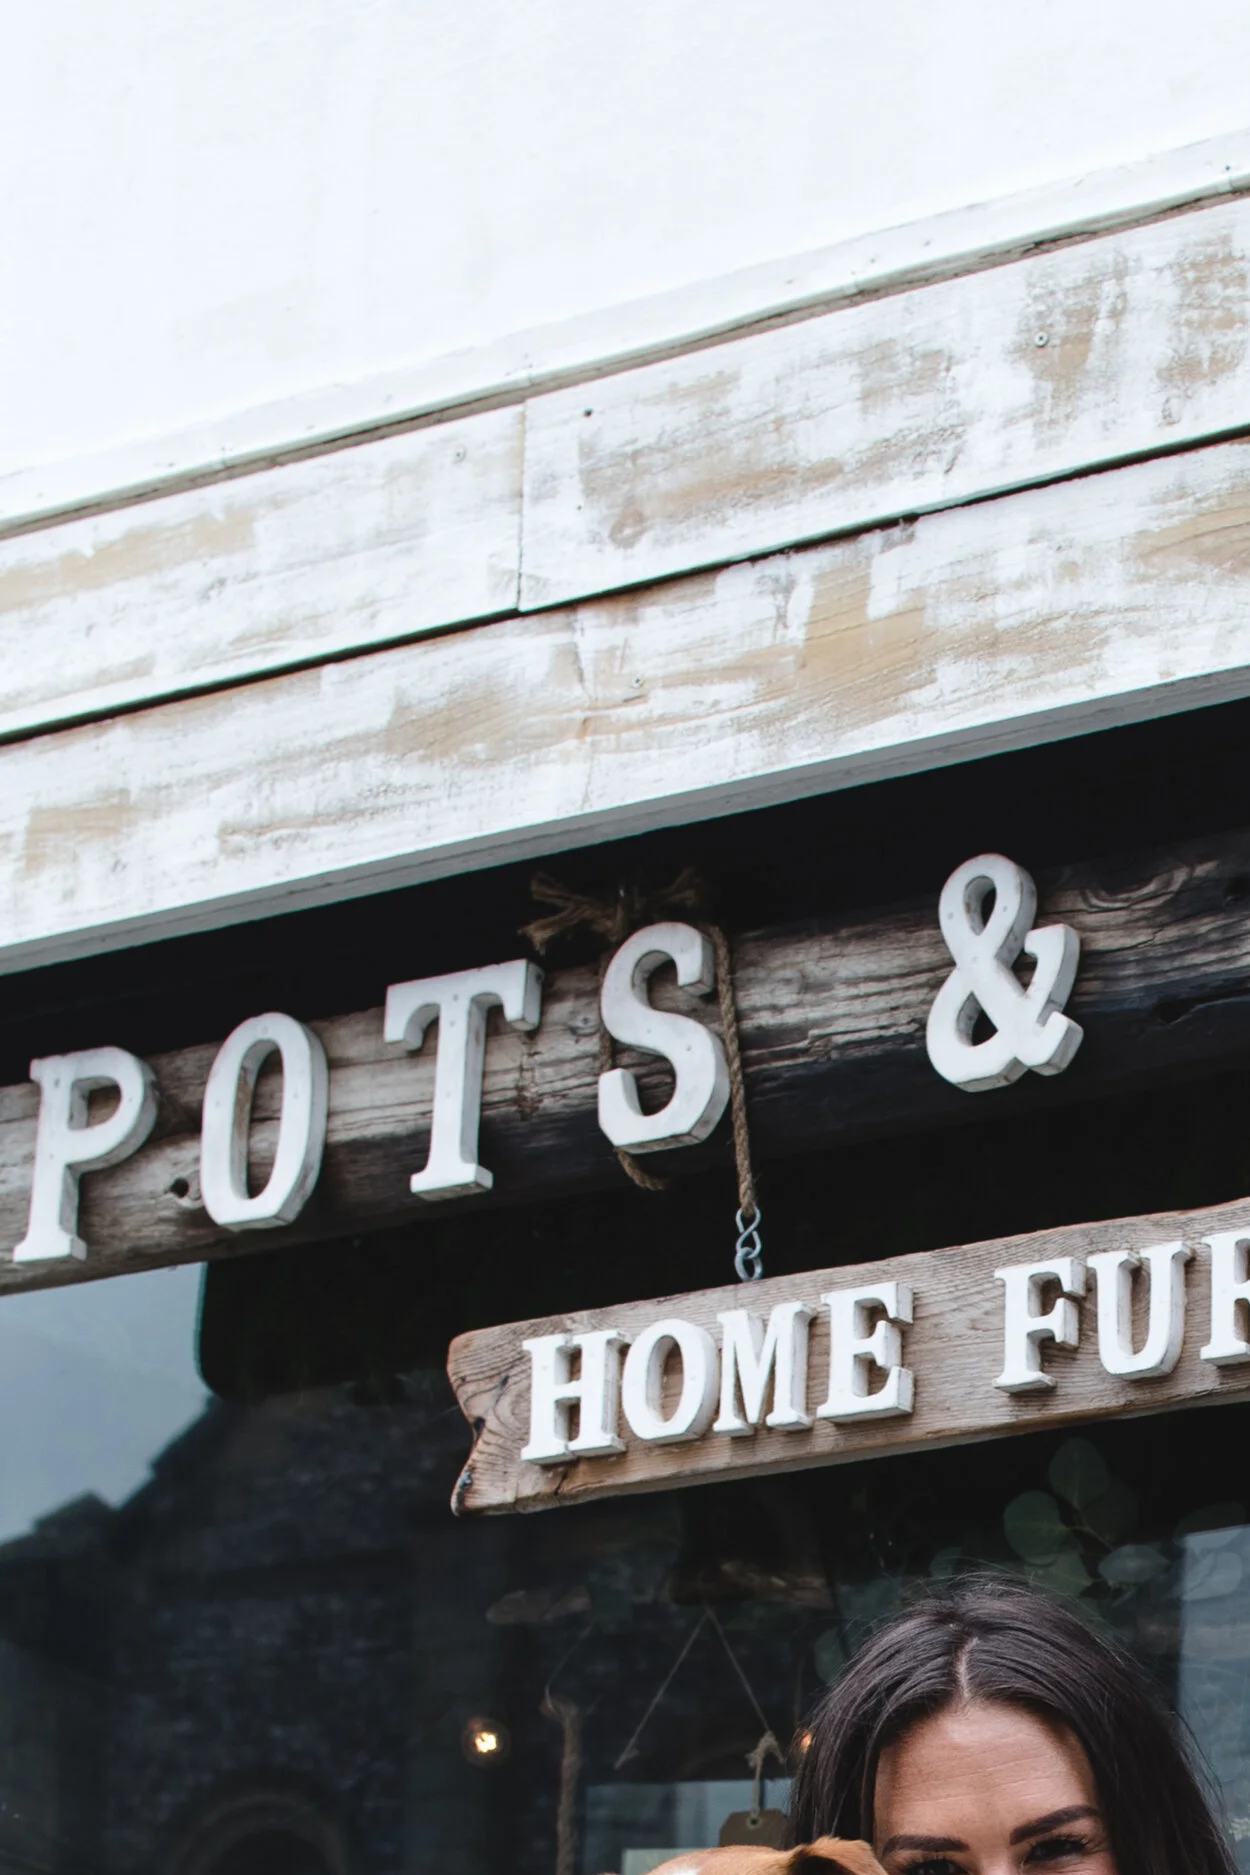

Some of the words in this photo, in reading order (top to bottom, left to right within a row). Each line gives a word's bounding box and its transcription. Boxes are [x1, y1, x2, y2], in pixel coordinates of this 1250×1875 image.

[12, 920, 730, 1264] POTS
[926, 852, 1084, 1093] &
[520, 1279, 915, 1466] HOME
